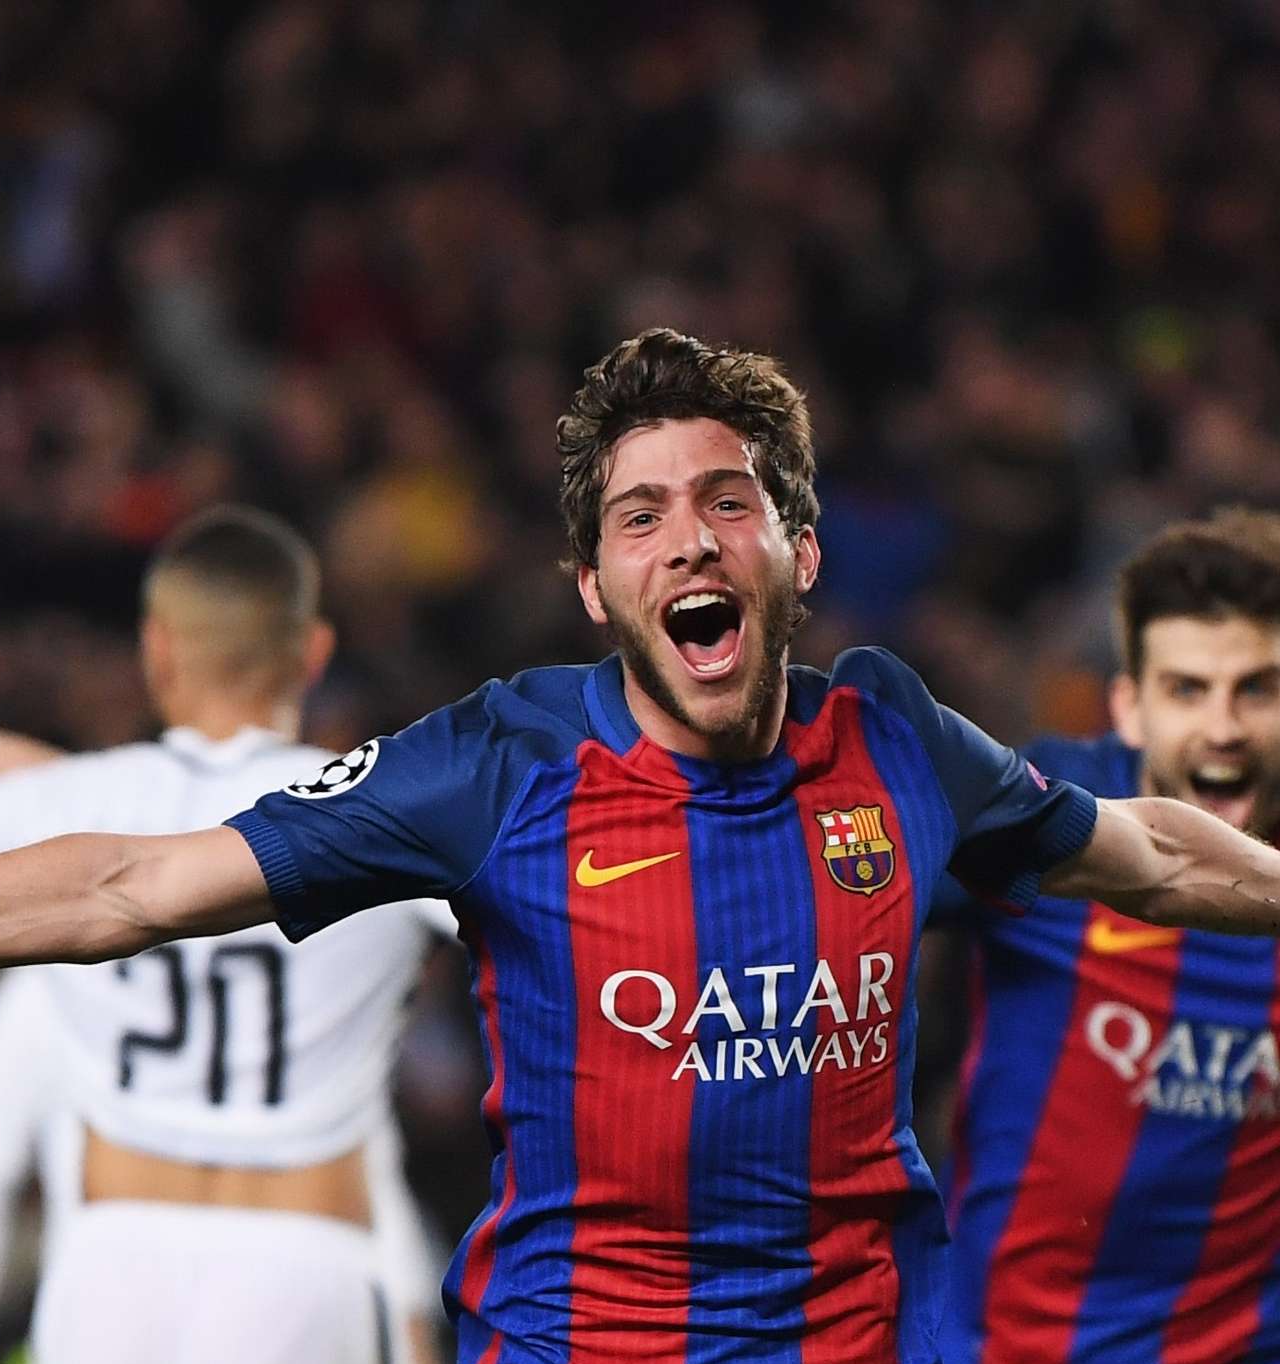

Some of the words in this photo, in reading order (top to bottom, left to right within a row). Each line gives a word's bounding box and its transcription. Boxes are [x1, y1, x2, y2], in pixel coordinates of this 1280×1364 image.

[845, 842, 872, 856] FCB
[600, 951, 893, 1050] QATAR
[671, 1021, 888, 1082] AIRWAYS
